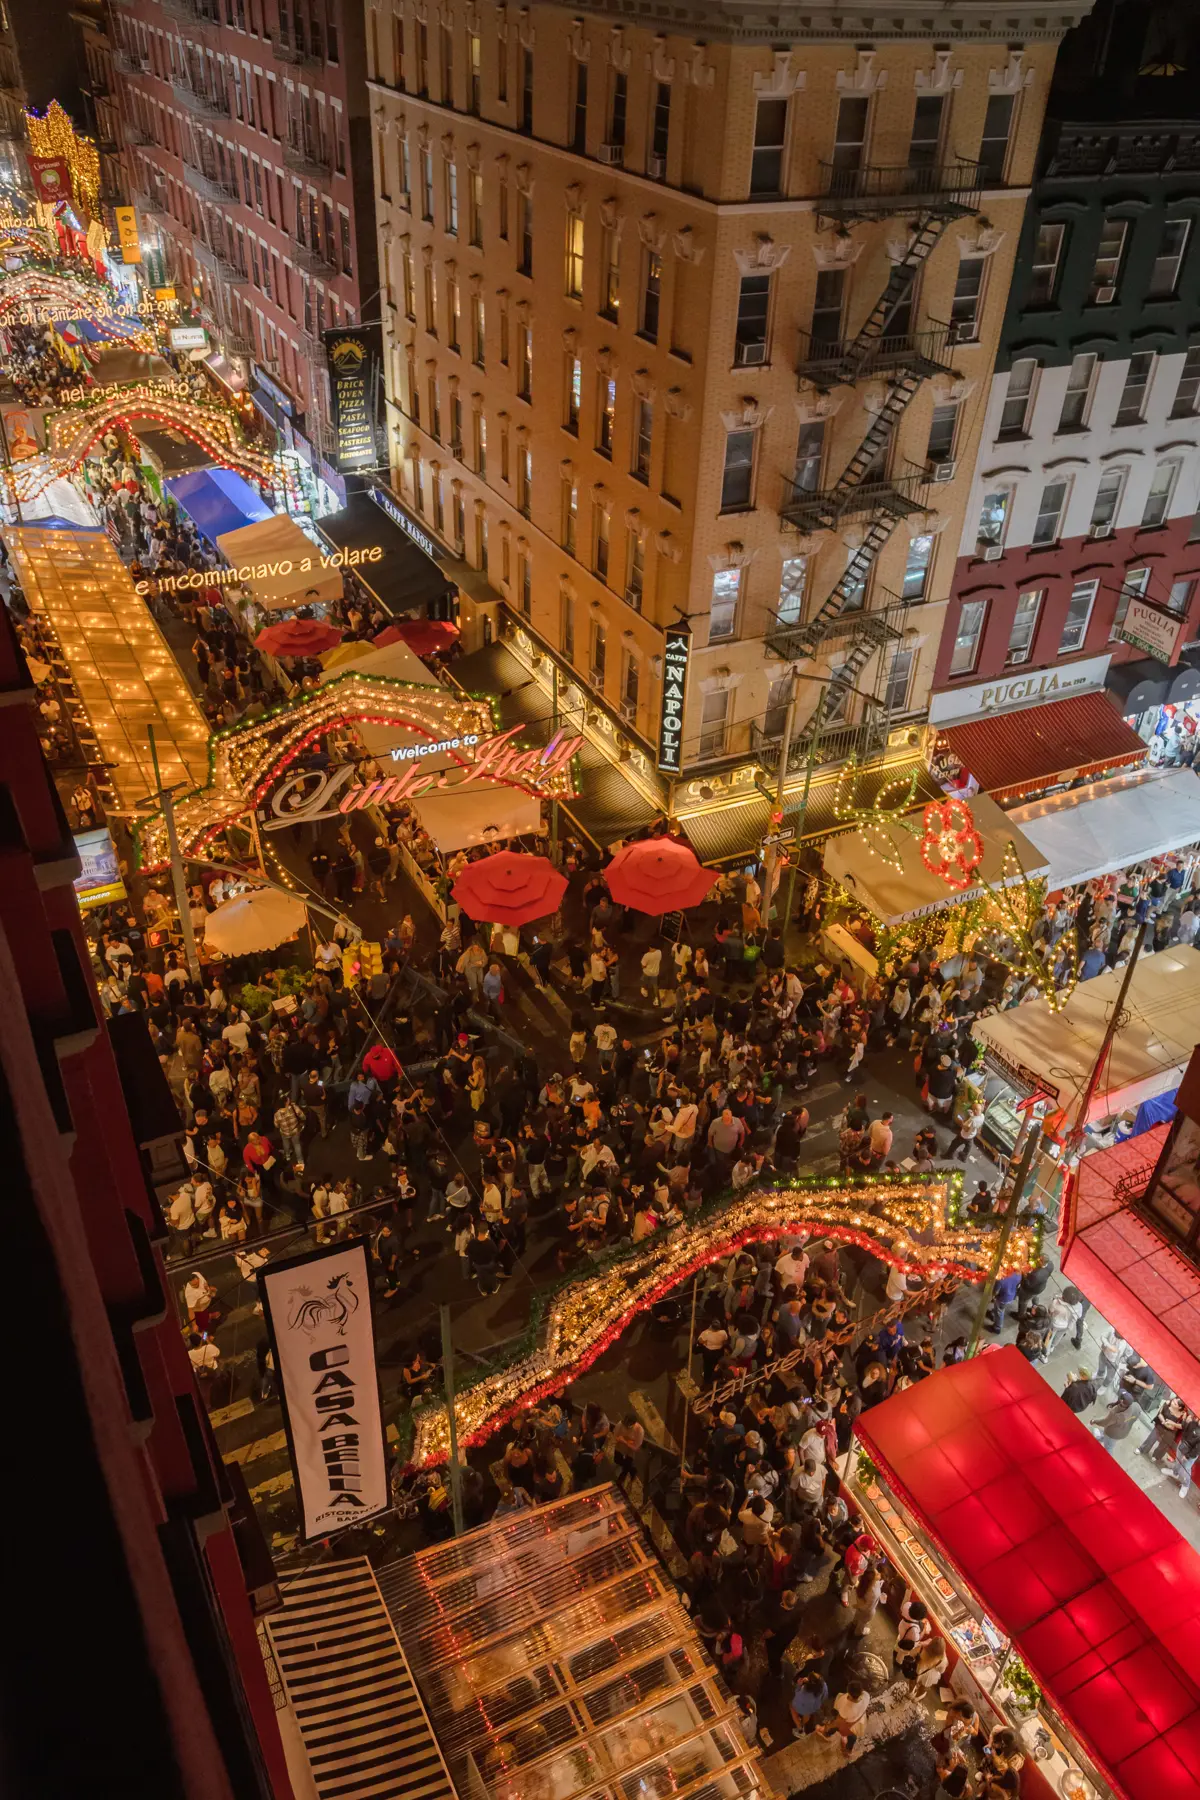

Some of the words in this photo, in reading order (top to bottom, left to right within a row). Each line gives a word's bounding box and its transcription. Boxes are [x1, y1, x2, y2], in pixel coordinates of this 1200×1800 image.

[20, 308, 36, 323] oh
[40, 306, 93, 324] Cantare
[96, 304, 113, 320] oh
[137, 300, 153, 315] oh
[157, 299, 172, 313] oh
[60, 384, 85, 403] nel
[337, 380, 365, 390] BRICK
[339, 389, 364, 399] OVEN
[338, 399, 365, 410] PIZZA
[340, 412, 366, 423] PASTA
[338, 425, 370, 436] SEAFOOD
[339, 436, 372, 448] PASTRIES
[384, 500, 406, 529] CAFFE
[407, 521, 433, 556] NAPOLI
[135, 579, 149, 596] e
[158, 560, 293, 592] incominciavo
[300, 557, 312, 573] a
[319, 546, 383, 569] volare
[1133, 607, 1175, 637] PUGLIA
[665, 653, 687, 663] CAFFE
[979, 672, 1060, 709] PUGLIA
[663, 665, 685, 763] NAPOLI
[391, 737, 460, 762] Welcome
[463, 734, 479, 747] to
[262, 762, 434, 831] Little
[437, 723, 588, 789] Italy
[901, 904, 942, 922] CAFFE
[944, 889, 984, 908] NAPOL
[1042, 1083, 1057, 1095] WAY
[315, 1503, 379, 1522] RISTORANTE
